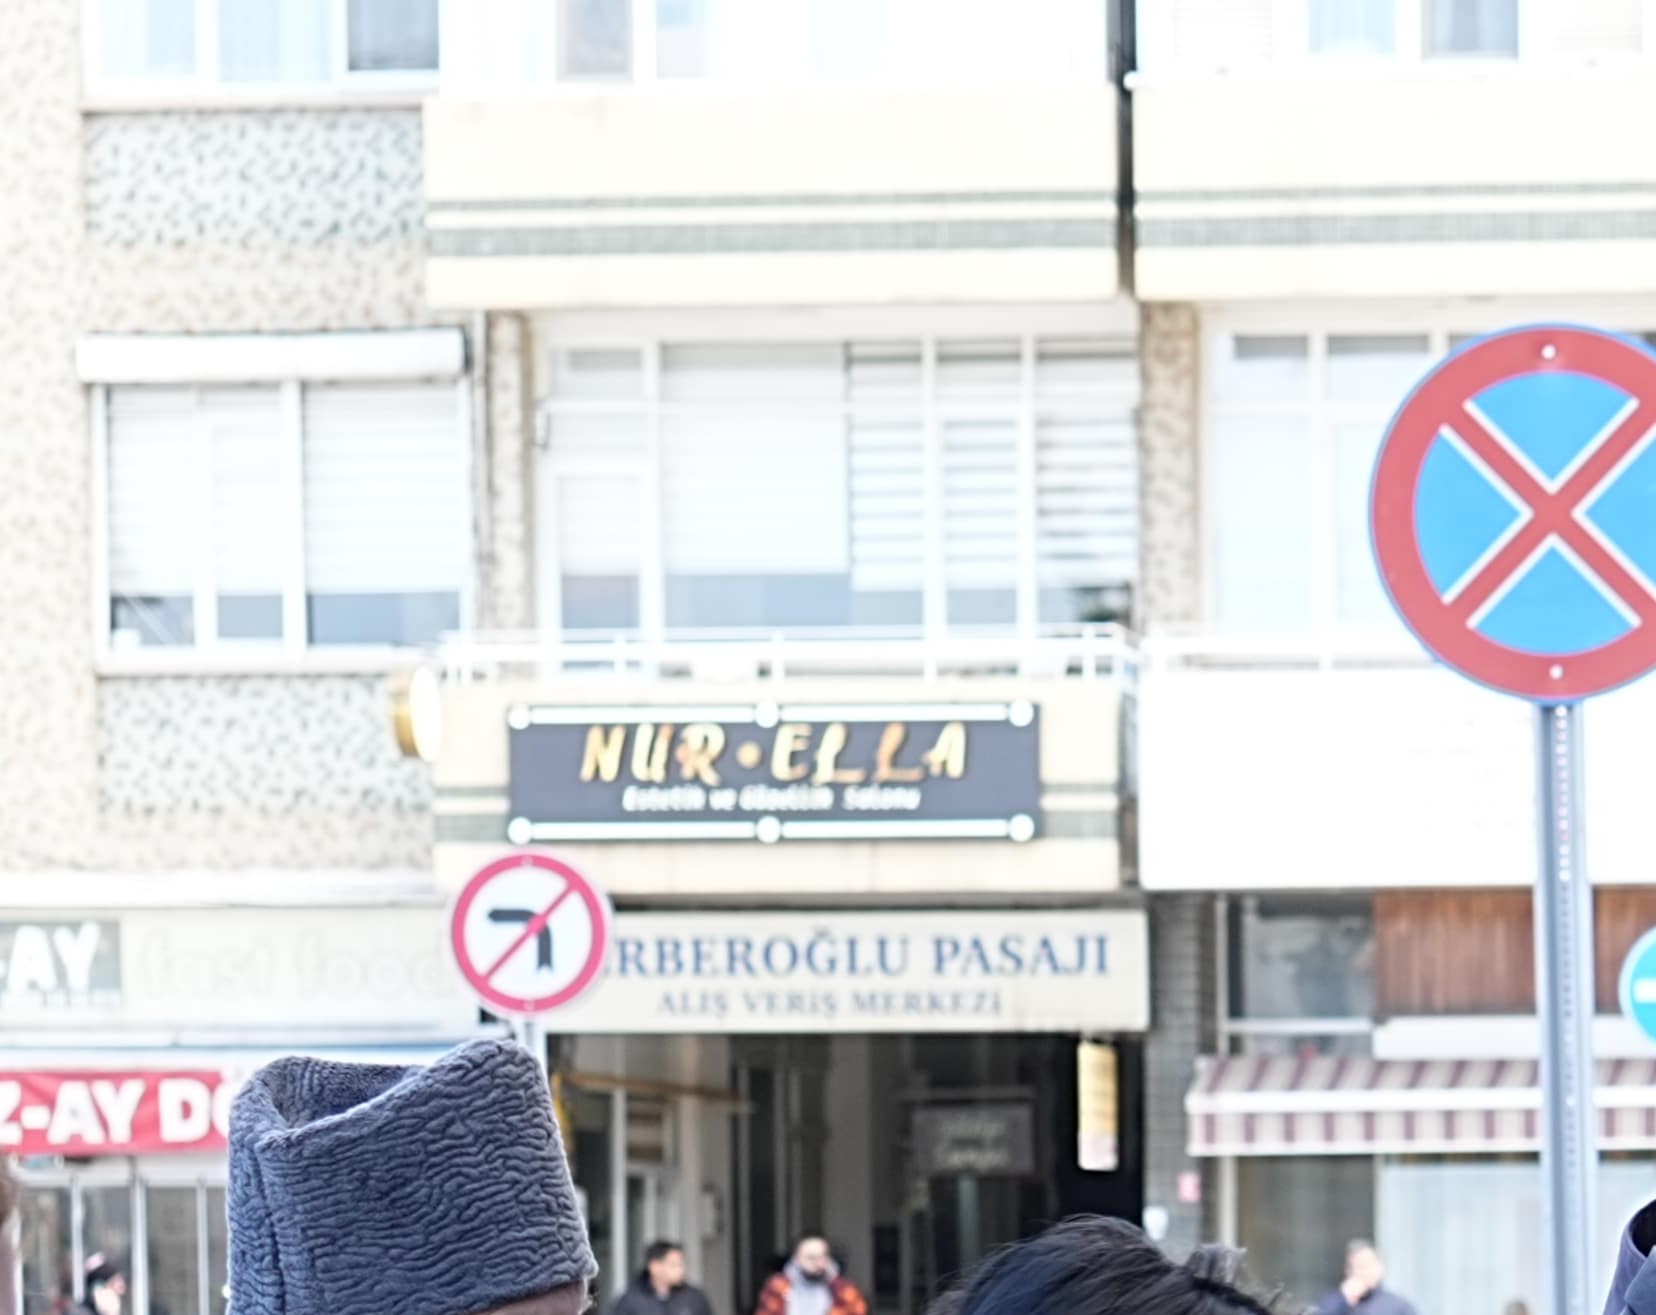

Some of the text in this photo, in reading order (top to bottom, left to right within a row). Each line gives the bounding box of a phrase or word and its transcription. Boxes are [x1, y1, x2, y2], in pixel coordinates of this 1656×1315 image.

[579, 722, 968, 786] NUR ELLA
[603, 924, 1113, 979] RBEROĞLU PASAJI
